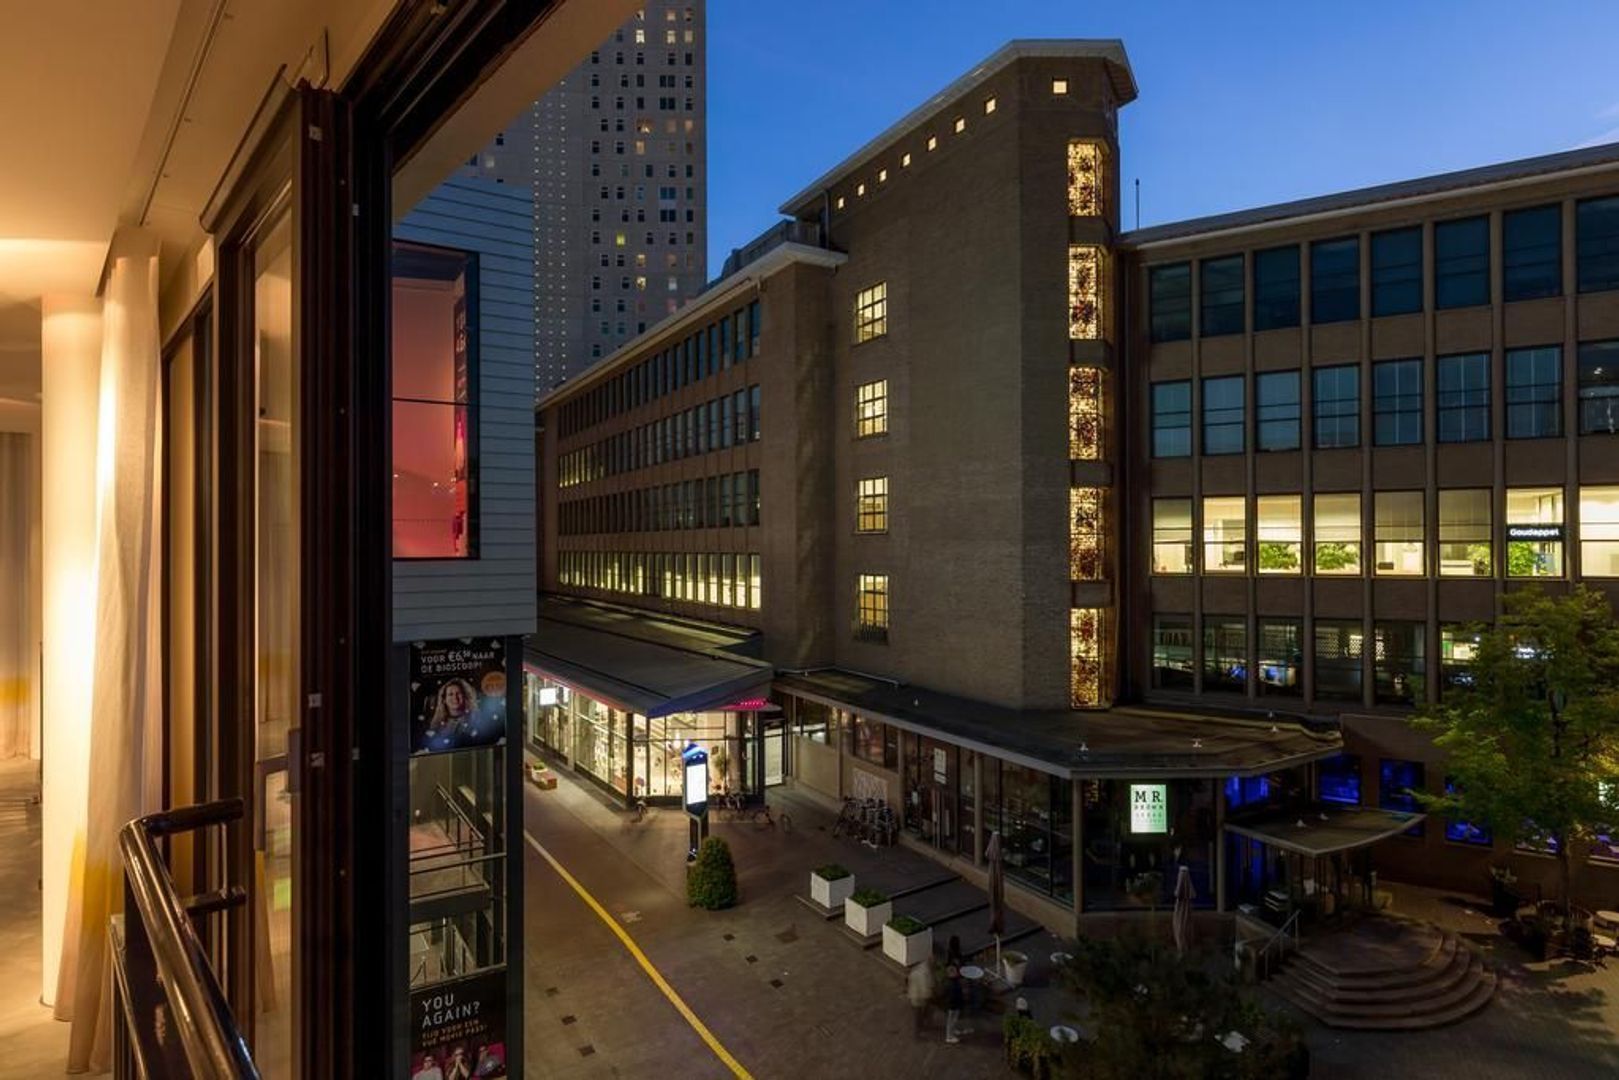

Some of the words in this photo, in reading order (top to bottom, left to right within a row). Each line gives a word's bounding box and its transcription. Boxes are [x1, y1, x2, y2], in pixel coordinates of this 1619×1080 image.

[1510, 528, 1560, 537] Goudappel
[421, 655, 446, 664] VOOR
[472, 651, 495, 659] NAAR
[421, 664, 433, 673] DE
[422, 993, 454, 1012] YOU
[422, 1001, 480, 1028] AGAIN?
